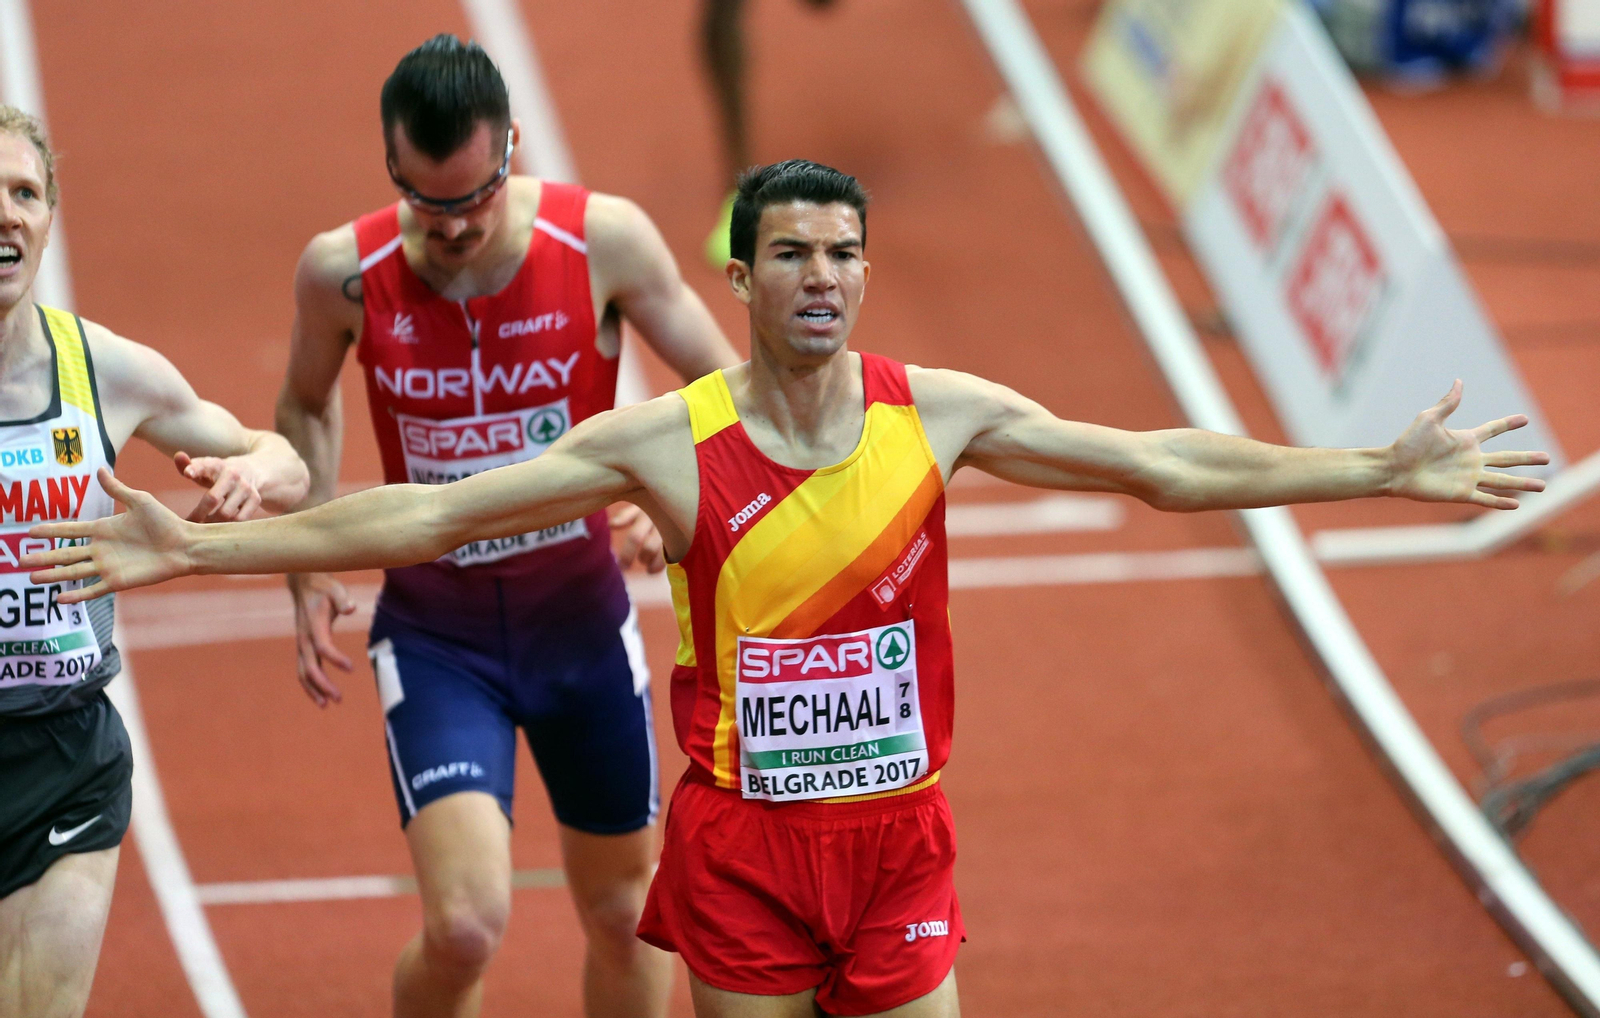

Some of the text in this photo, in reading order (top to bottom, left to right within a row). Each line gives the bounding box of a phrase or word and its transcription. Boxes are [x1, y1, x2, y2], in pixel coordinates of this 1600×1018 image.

[498, 311, 555, 339] CRAFT
[374, 351, 581, 400] NORWAY
[405, 421, 521, 457] SPAR
[1, 448, 44, 467] DKB
[0, 474, 91, 525] MANY
[0, 583, 63, 629] GER
[11, 638, 61, 655] CLEAN
[742, 641, 870, 678] SPAR
[54, 653, 95, 678] 2017
[742, 687, 890, 738] MECHAAL
[782, 742, 880, 766] I RUN CLEAN
[412, 761, 470, 791] CRAFT
[747, 757, 921, 797] BELGRADE 2017
